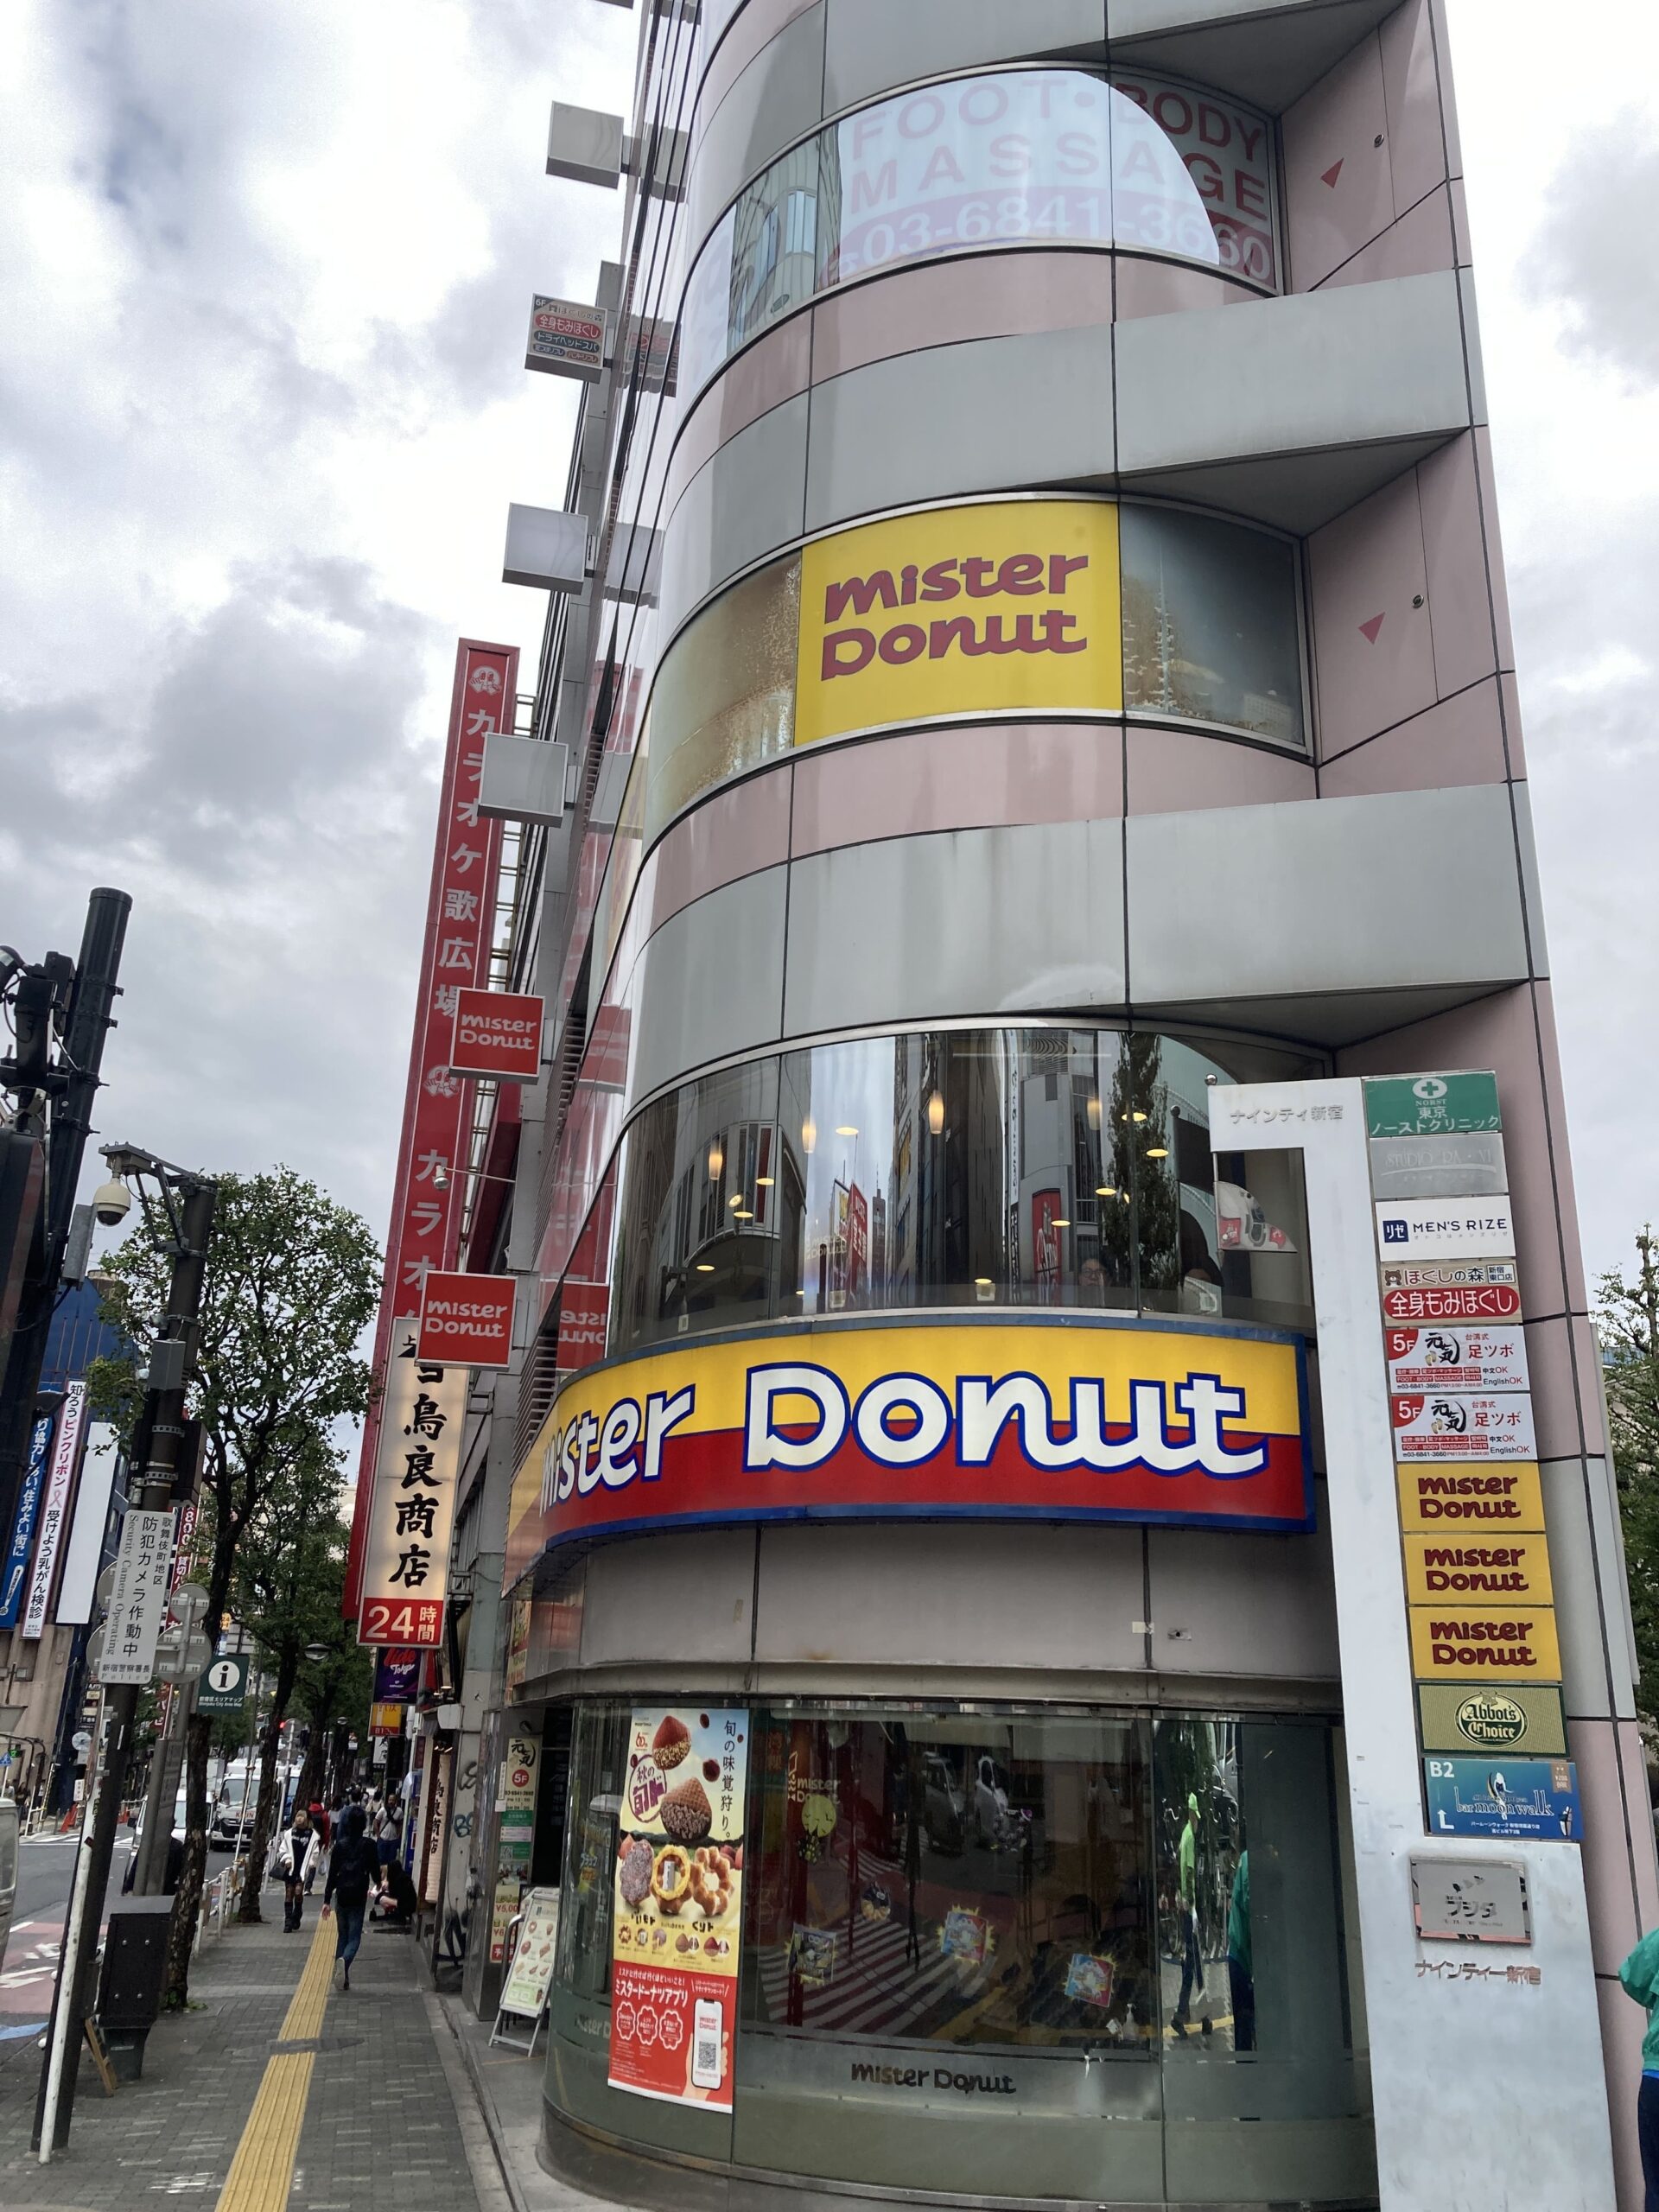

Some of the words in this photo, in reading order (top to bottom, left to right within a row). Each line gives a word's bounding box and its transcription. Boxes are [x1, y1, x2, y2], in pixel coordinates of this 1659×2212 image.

[850, 131, 1268, 221] MASSAGE
[536, 298, 547, 307] 6F
[539, 314, 599, 339] 全身もみほぐし
[537, 332, 597, 352] ドライヘッドスパ
[821, 609, 1088, 682] Donut
[459, 1027, 535, 1051] Donut
[1230, 1105, 1343, 1125] ナインティ新宿
[1417, 1106, 1448, 1119] 東京
[1371, 1115, 1499, 1135] ノーストクリニック
[401, 1148, 449, 1318] カラオ
[1386, 1224, 1405, 1239] リゼ
[1413, 1220, 1460, 1233] MEN'S
[1465, 1218, 1508, 1230] RIZE
[1404, 1267, 1484, 1286] ほぐしの森
[1489, 1273, 1513, 1281] 東口店
[1390, 1288, 1512, 1317] 全身もみほぐし
[424, 1317, 505, 1338] Donut
[1465, 1332, 1490, 1341] 台湾式
[1393, 1333, 1415, 1352] 5F
[1468, 1344, 1515, 1359] 足ツボ
[743, 1360, 1269, 1481] Donut
[1398, 1401, 1421, 1420] 5F
[1475, 1411, 1521, 1427] 足ツボ
[54, 1383, 85, 1487] 知ろうピンクリボン
[1420, 1498, 1522, 1519] Donut
[123, 1515, 138, 1555] Security
[153, 1516, 173, 1586] 歌舞伎町地区
[29, 1510, 60, 1620] 受けよう乳がん検診
[117, 1559, 131, 1600] Camera
[123, 1516, 159, 1658] 防犯カメラ作動中
[1426, 1570, 1529, 1592] Donut
[105, 1603, 125, 1656] Operating
[1432, 1643, 1537, 1666] Donut
[102, 1663, 150, 1674] 新宿警察署長
[1465, 1703, 1517, 1720] Abbot's
[1467, 1720, 1516, 1738] Choice
[514, 1773, 529, 1783] 5F
[637, 1766, 655, 1784] 秋の
[721, 1719, 736, 1838] 旬の味覚狩り。
[1429, 1761, 1455, 1778] B2
[797, 1789, 841, 1805] Dot
[1454, 1786, 1475, 1813] bar
[235, 1810, 254, 1819] KIN
[1446, 1900, 1497, 1918] フジタ
[1414, 1959, 1541, 1986] ナインティー新宿
[615, 1978, 689, 2008] ミスタードーナツアプリ
[933, 2069, 1017, 2094] Donut
